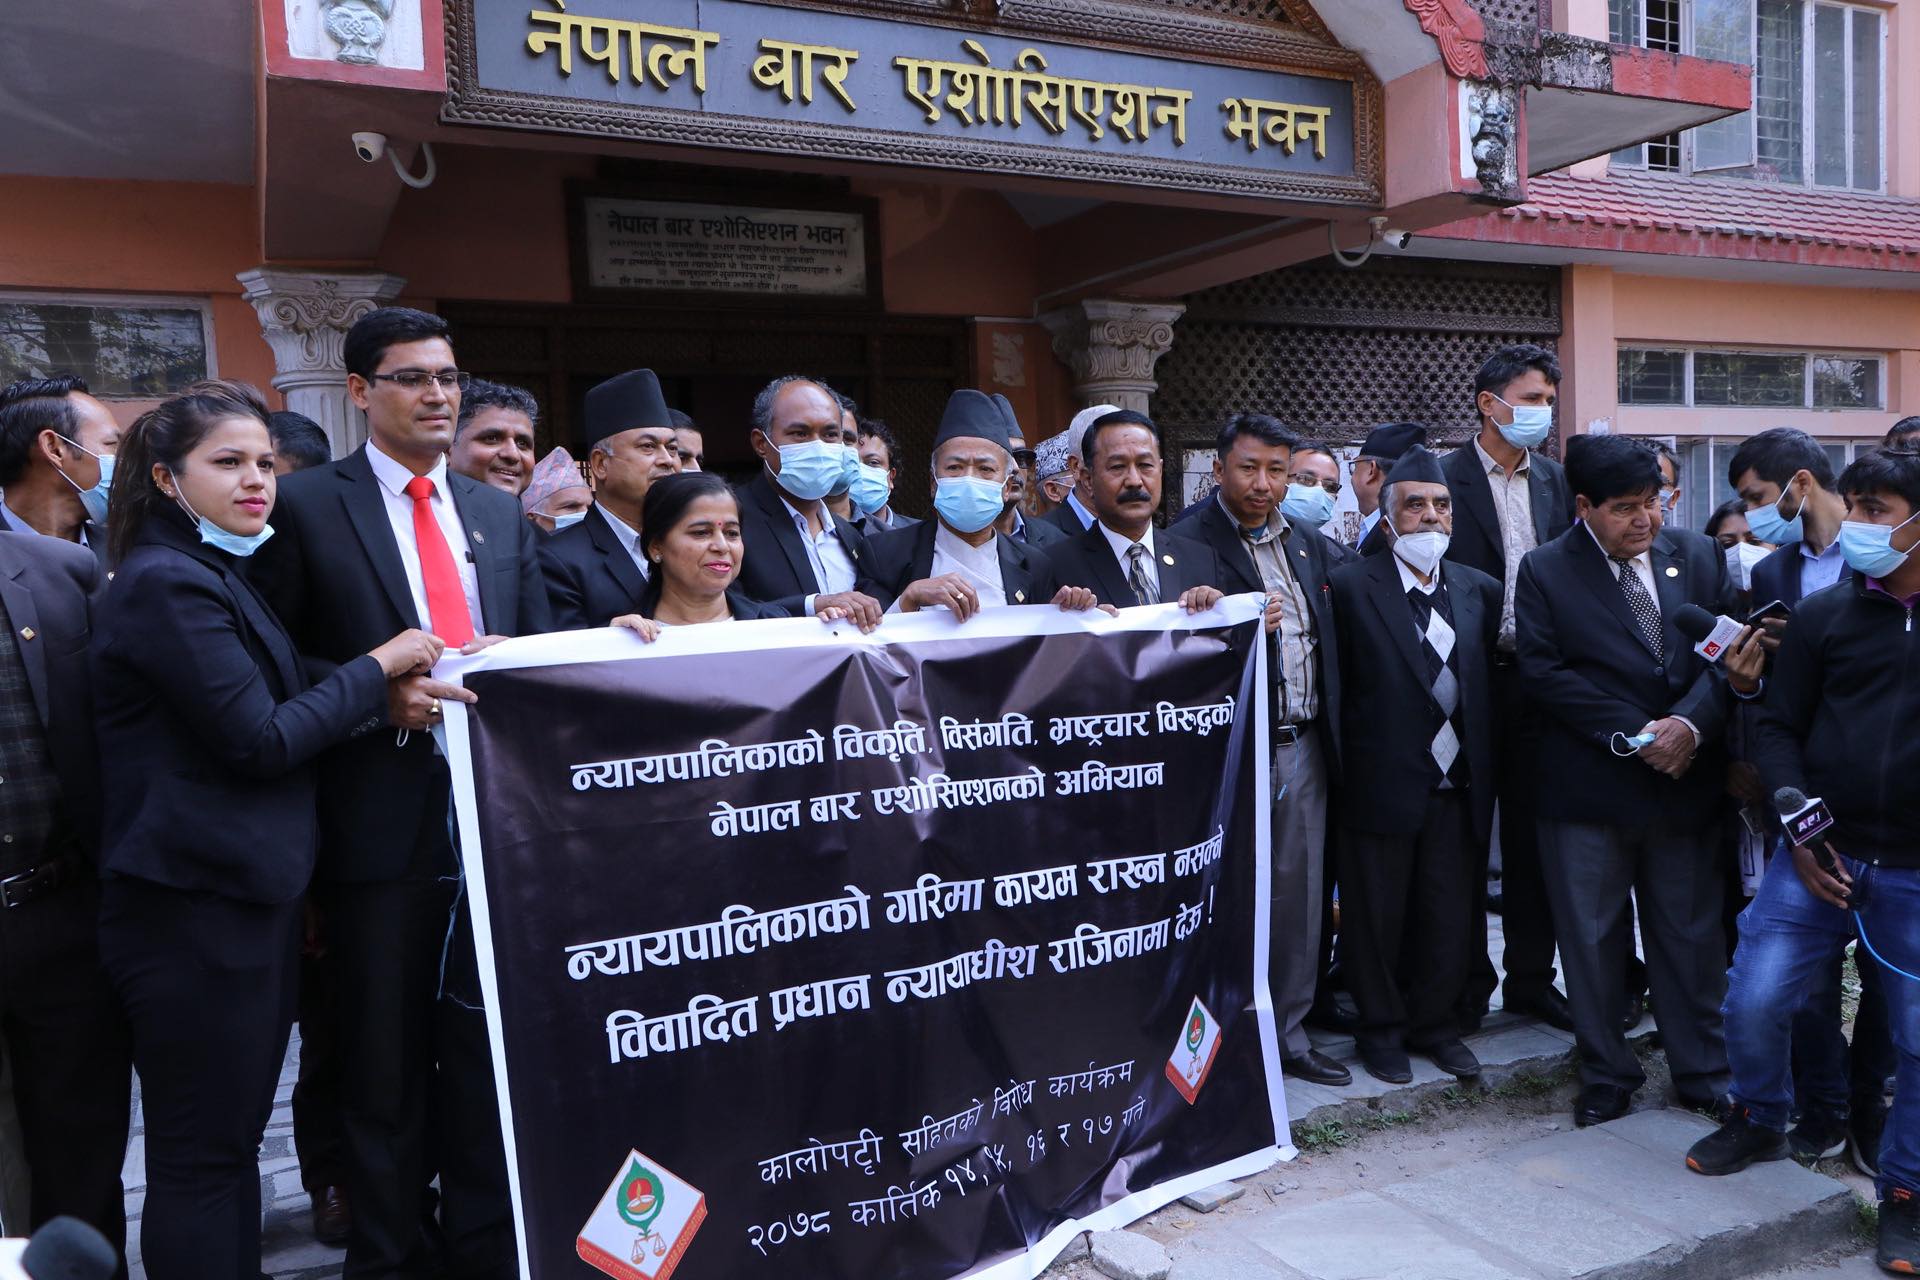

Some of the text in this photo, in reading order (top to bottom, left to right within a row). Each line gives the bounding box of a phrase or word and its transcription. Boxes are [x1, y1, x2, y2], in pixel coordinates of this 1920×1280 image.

[526, 9, 1331, 160] नेपाल बार एशोसिएशन भवन
[607, 210, 659, 236] नेपाल
[664, 216, 693, 236] बार
[804, 223, 846, 245] भवन
[570, 729, 825, 791] न्यायपालिकाको
[709, 760, 1165, 837] नेपाल बार एशोसिएशनको अभियान
[564, 823, 1225, 981] न्यायपालिकाको गरिमा कायम राख्न नसक्ने
[605, 993, 759, 1063] विवादित
[769, 974, 871, 1032] प्रधान
[884, 938, 1040, 1004] न्यायाधीश
[1048, 918, 1171, 974] राजिनामा
[899, 1098, 985, 1158] सहितको
[992, 1079, 1037, 1119] विरोध
[1048, 1060, 1136, 1099] कार्यक्रम
[747, 1210, 832, 1257] २०७८
[848, 1180, 942, 1227] कार्तिक
[1027, 1128, 1046, 1161] १६
[1057, 1122, 1072, 1148] र
[1082, 1114, 1114, 1144] १७
[1121, 1095, 1147, 1127] गते
